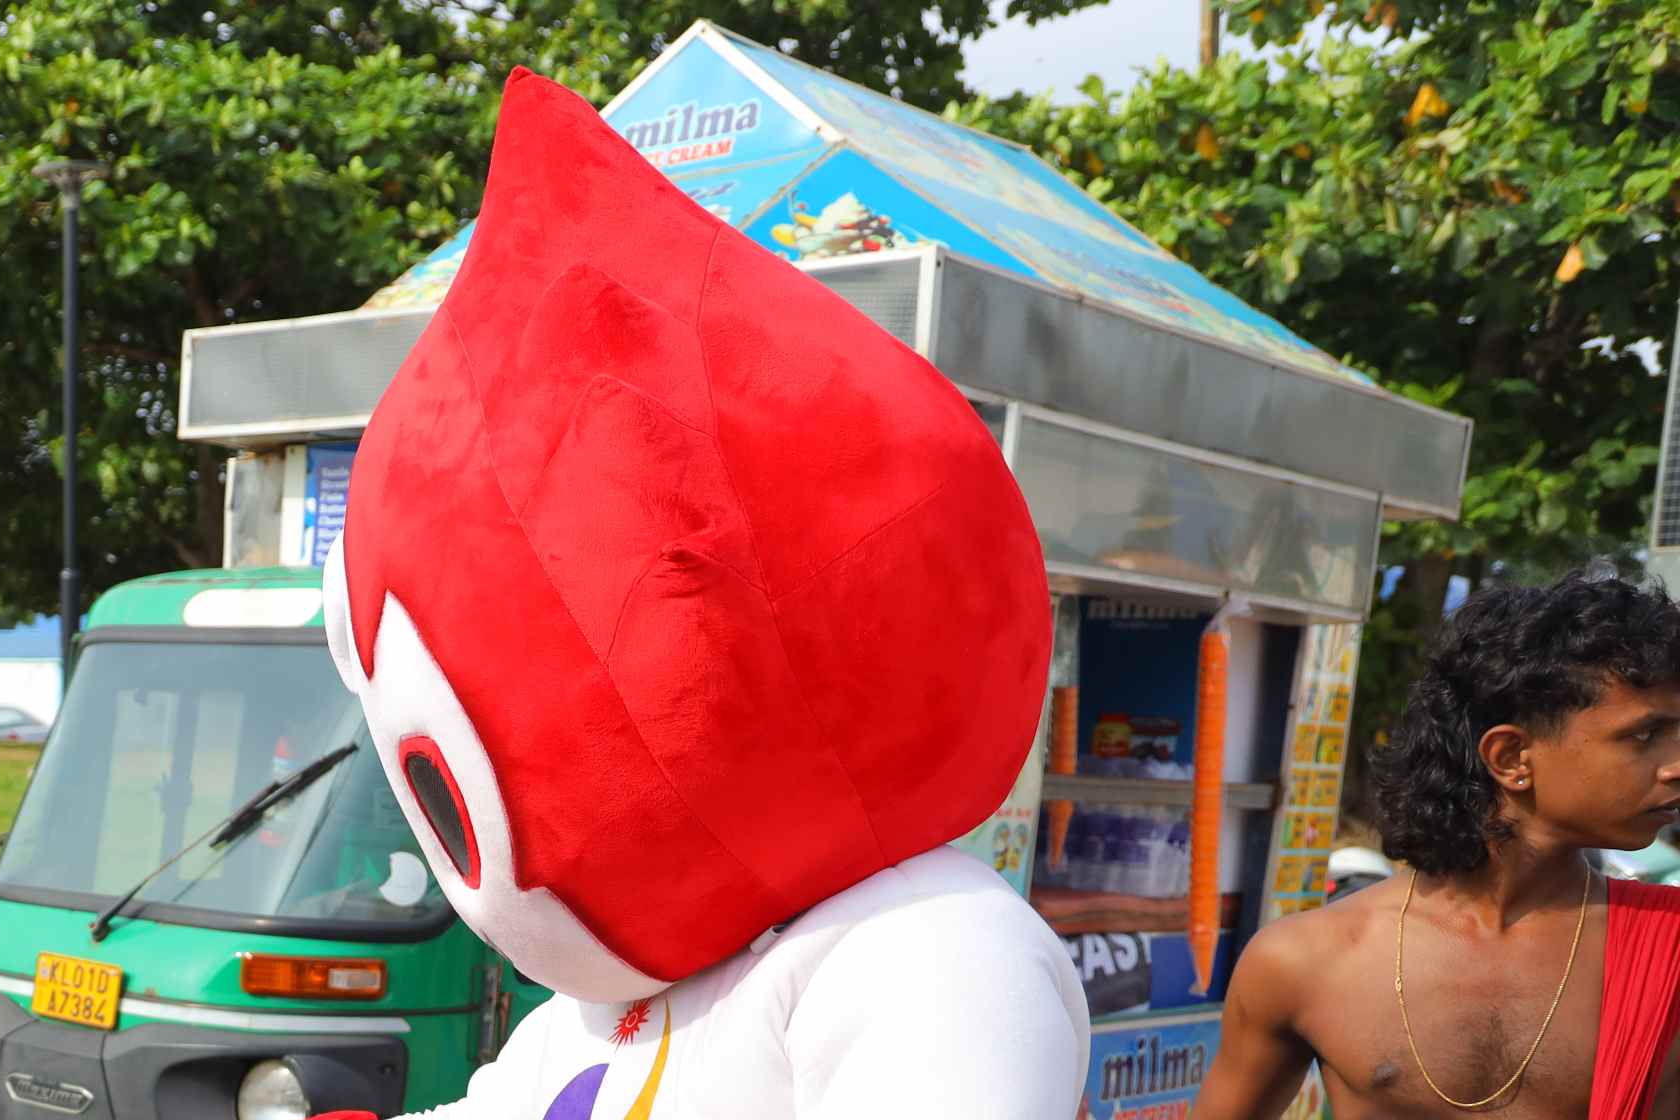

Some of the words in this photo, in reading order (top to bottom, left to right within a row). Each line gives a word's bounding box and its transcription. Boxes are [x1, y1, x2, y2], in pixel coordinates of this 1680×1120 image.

[625, 102, 758, 148] milma
[47, 989, 106, 1024] A7384
[1100, 1034, 1205, 1101] milma
